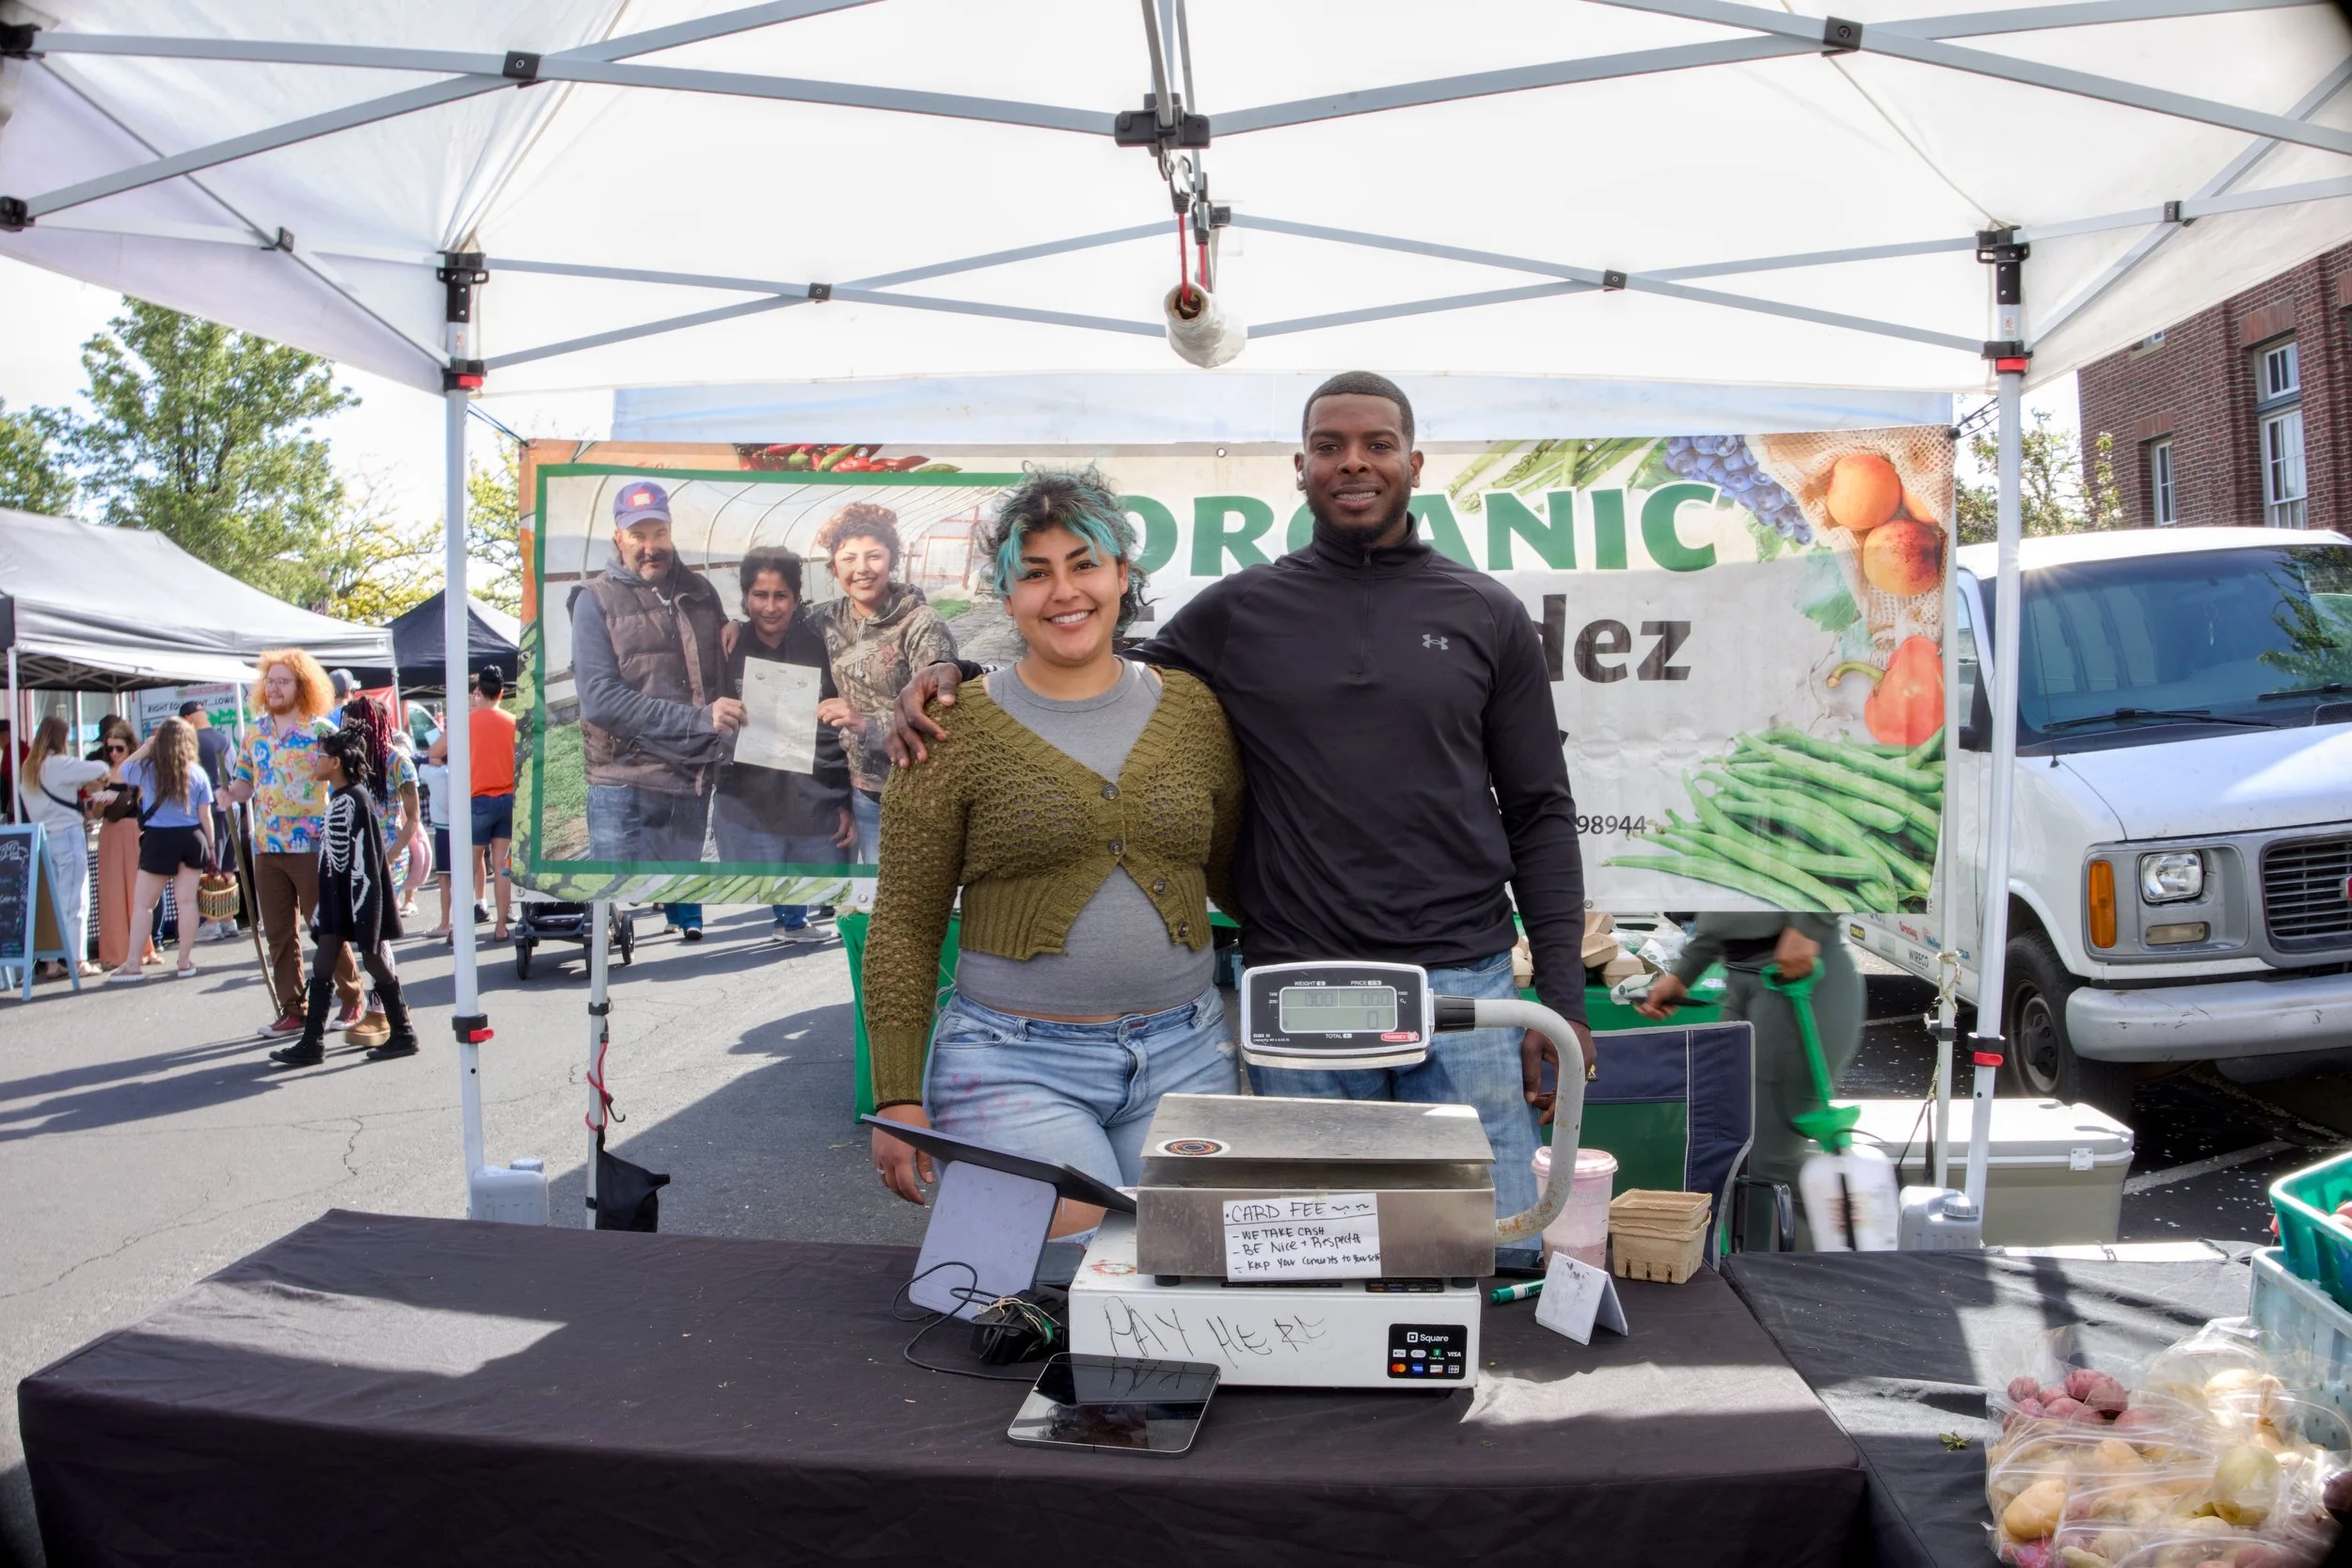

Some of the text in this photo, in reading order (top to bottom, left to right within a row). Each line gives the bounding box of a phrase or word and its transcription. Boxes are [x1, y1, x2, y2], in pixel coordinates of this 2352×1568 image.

[1576, 815, 1647, 835] 98944
[1232, 1201, 1327, 1223] CARD FEE
[1242, 1226, 1325, 1241] WE TAKE CASH
[1242, 1243, 1263, 1257] BE
[1271, 1241, 1299, 1254] Nice
[1342, 1254, 1351, 1263] to
[1104, 1295, 1333, 1370] PAY HERE
[1420, 1334, 1449, 1343] Square
